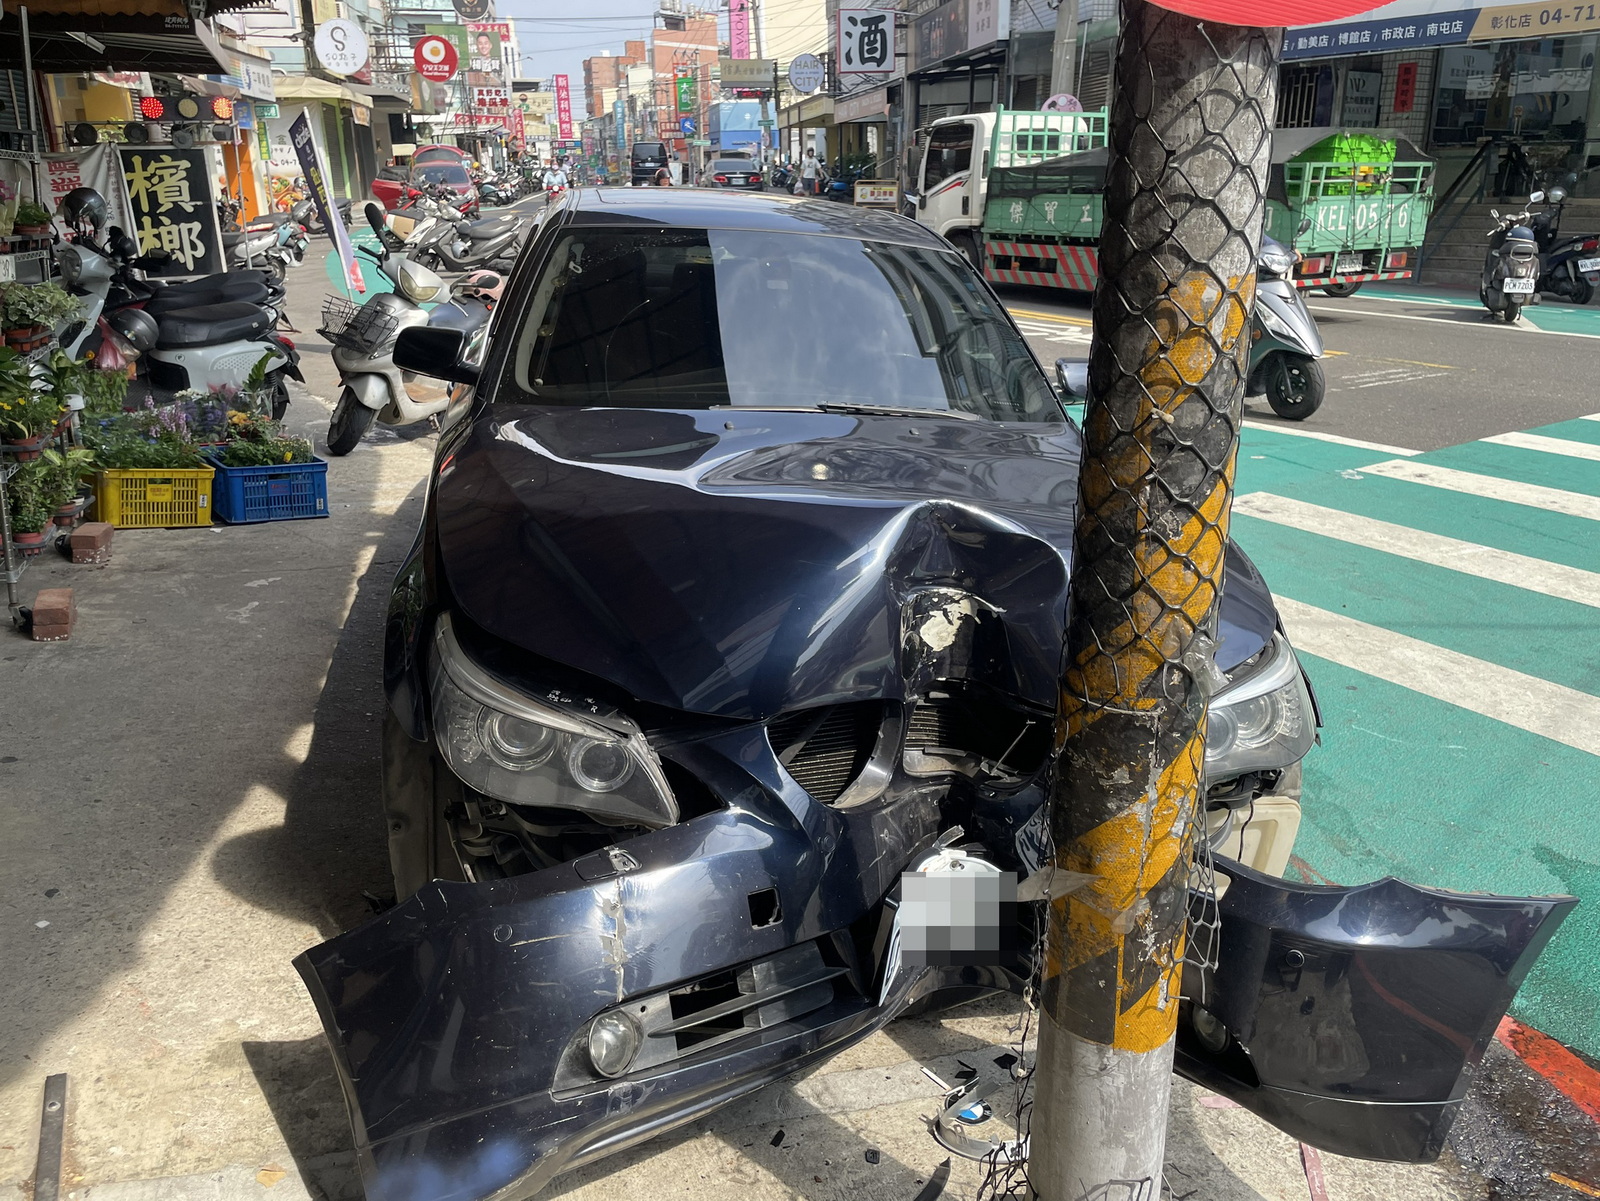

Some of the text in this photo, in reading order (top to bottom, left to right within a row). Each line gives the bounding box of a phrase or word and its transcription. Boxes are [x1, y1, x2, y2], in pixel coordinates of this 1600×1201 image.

[1491, 4, 1600, 30] 彰化店 04-71
[845, 14, 888, 67] 酒
[1382, 26, 1416, 41] 市政店
[1427, 20, 1463, 36] 南屯店
[795, 61, 819, 70] HAIR
[795, 77, 820, 87] CITY
[125, 155, 206, 271] 檳榔
